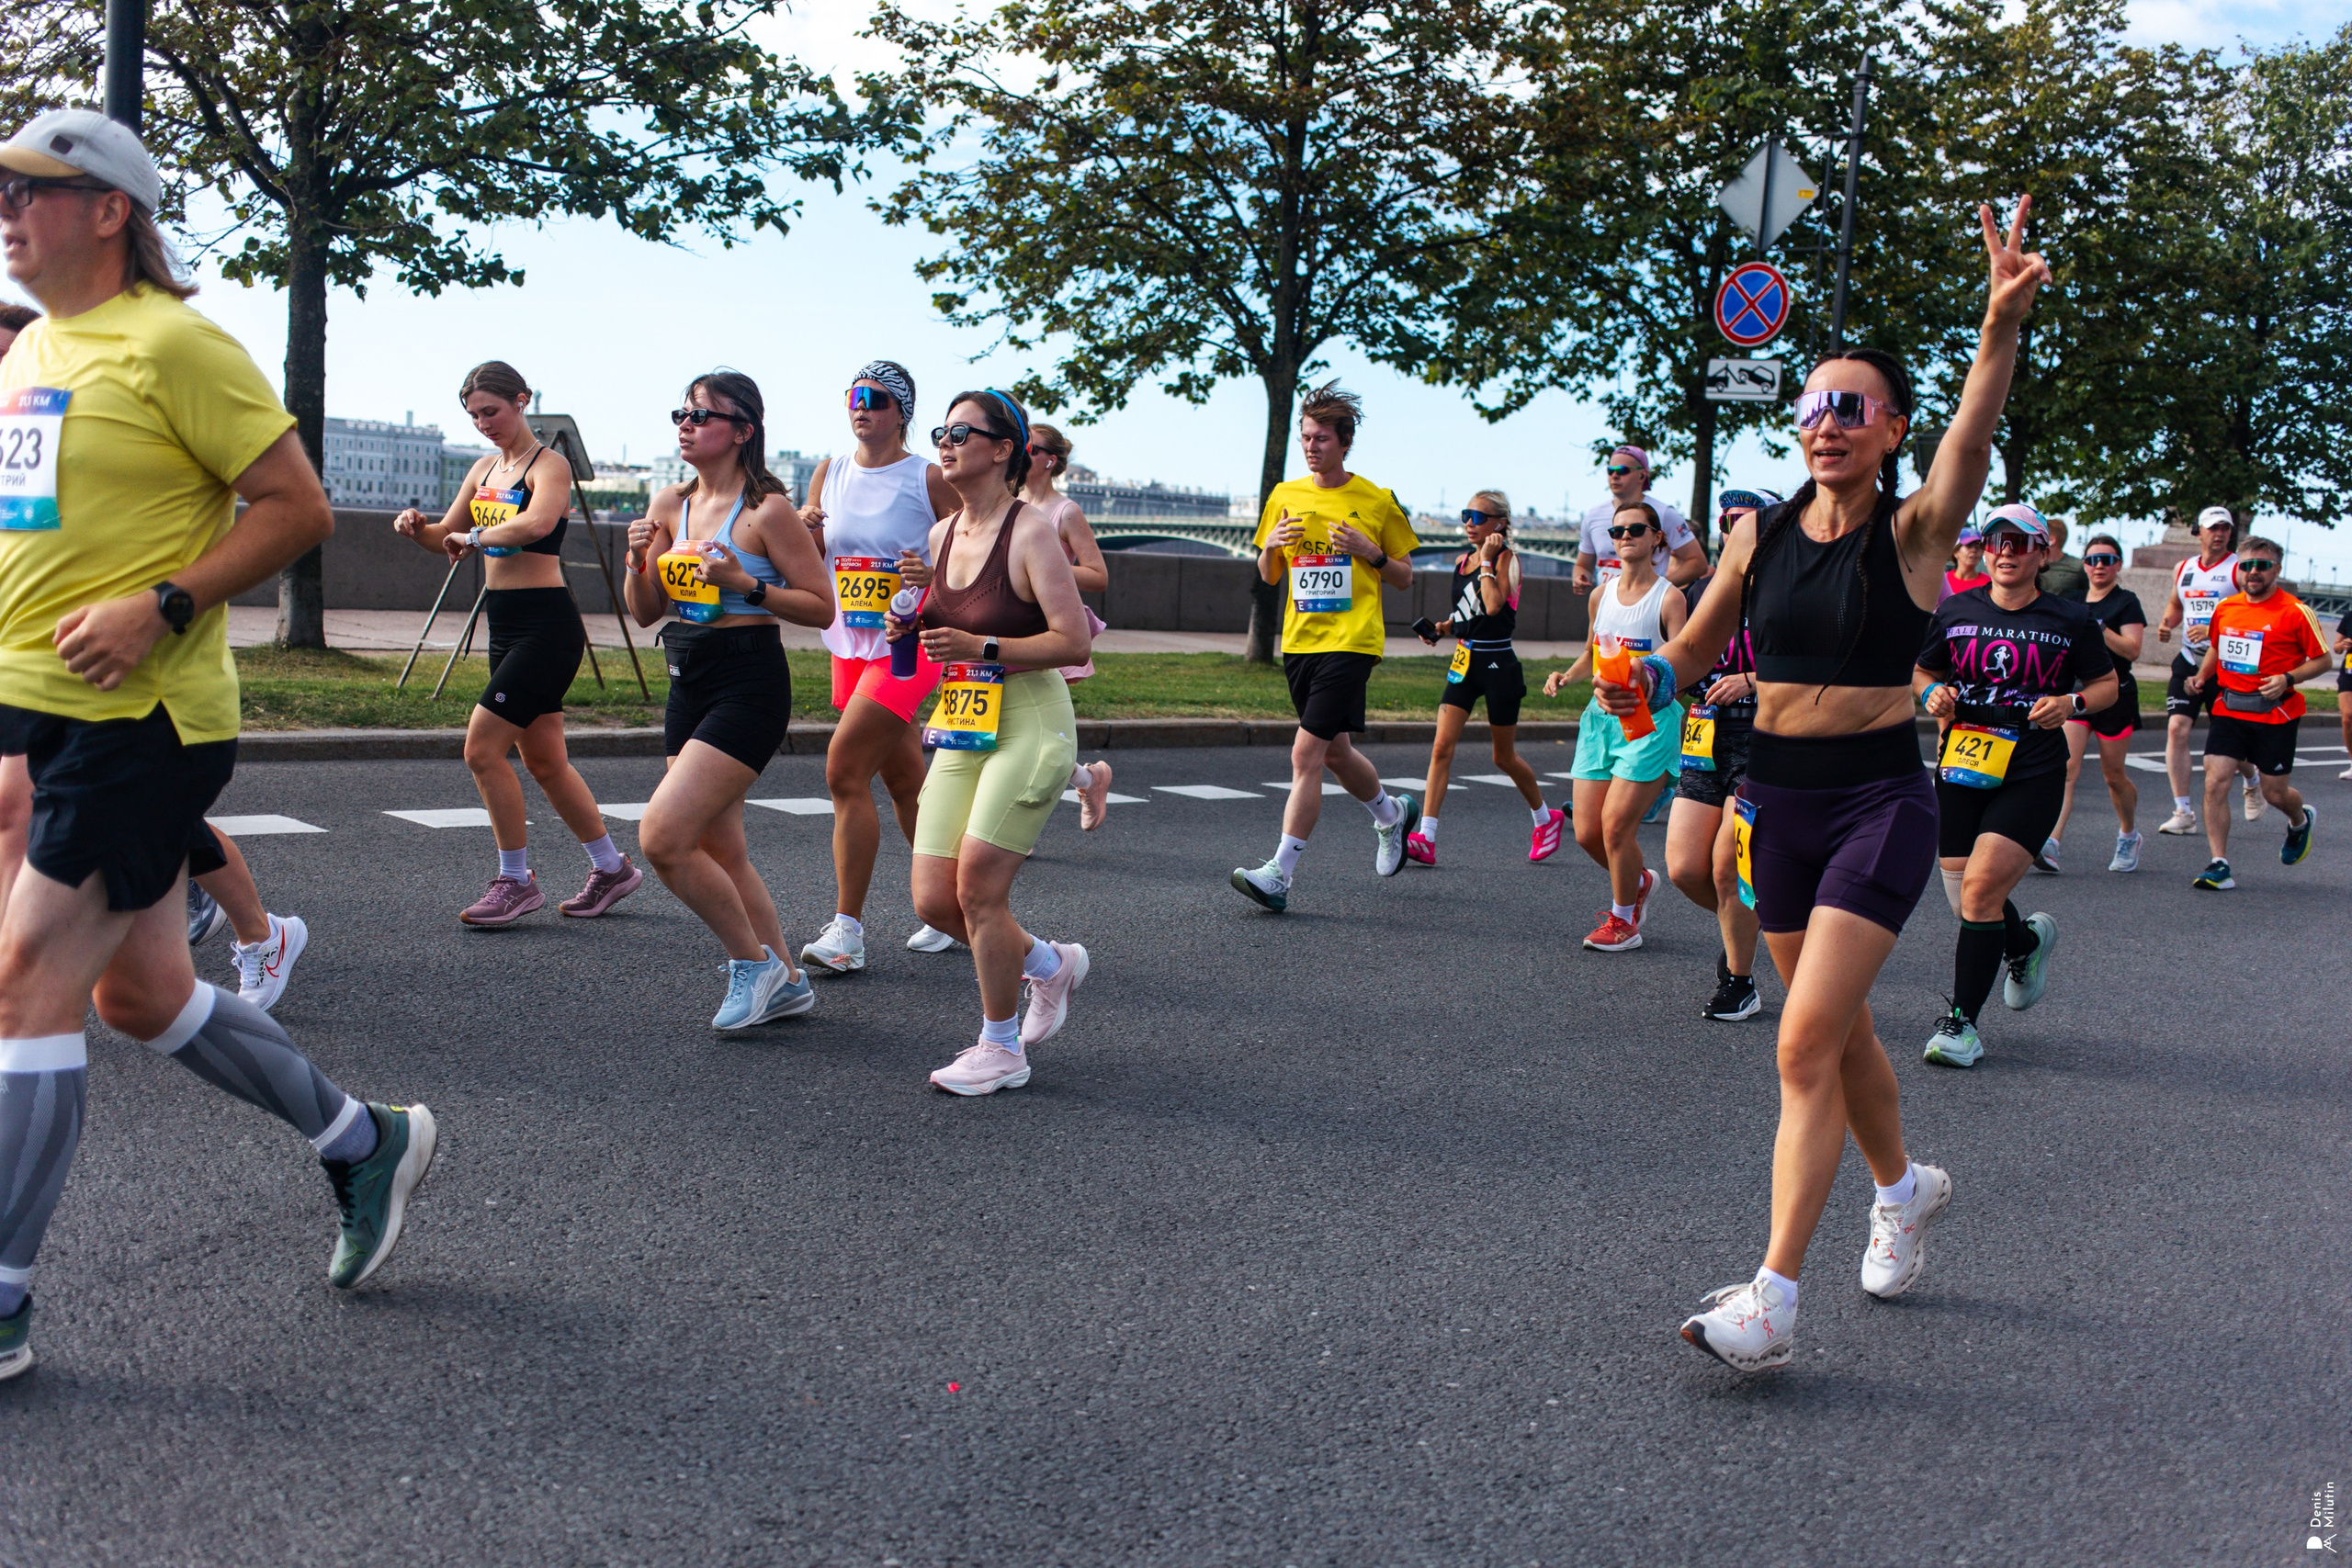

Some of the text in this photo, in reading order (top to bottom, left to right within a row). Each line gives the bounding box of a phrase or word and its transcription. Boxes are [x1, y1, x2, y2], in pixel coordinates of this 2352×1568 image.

[0, 427, 42, 469] 23
[475, 506, 506, 526] 3666
[840, 577, 891, 600] 2695
[1299, 570, 1343, 589] 6790
[2190, 600, 2215, 612] 1579
[1947, 626, 1977, 637] HALF
[1981, 626, 2073, 648] MARATHON
[2227, 640, 2250, 656] 551
[1949, 637, 2068, 689] MOM
[944, 689, 989, 716] 5875
[1954, 736, 1994, 761] 421
[1957, 757, 1980, 768] ОЛЕСЯ
[1736, 827, 1743, 859] 6
